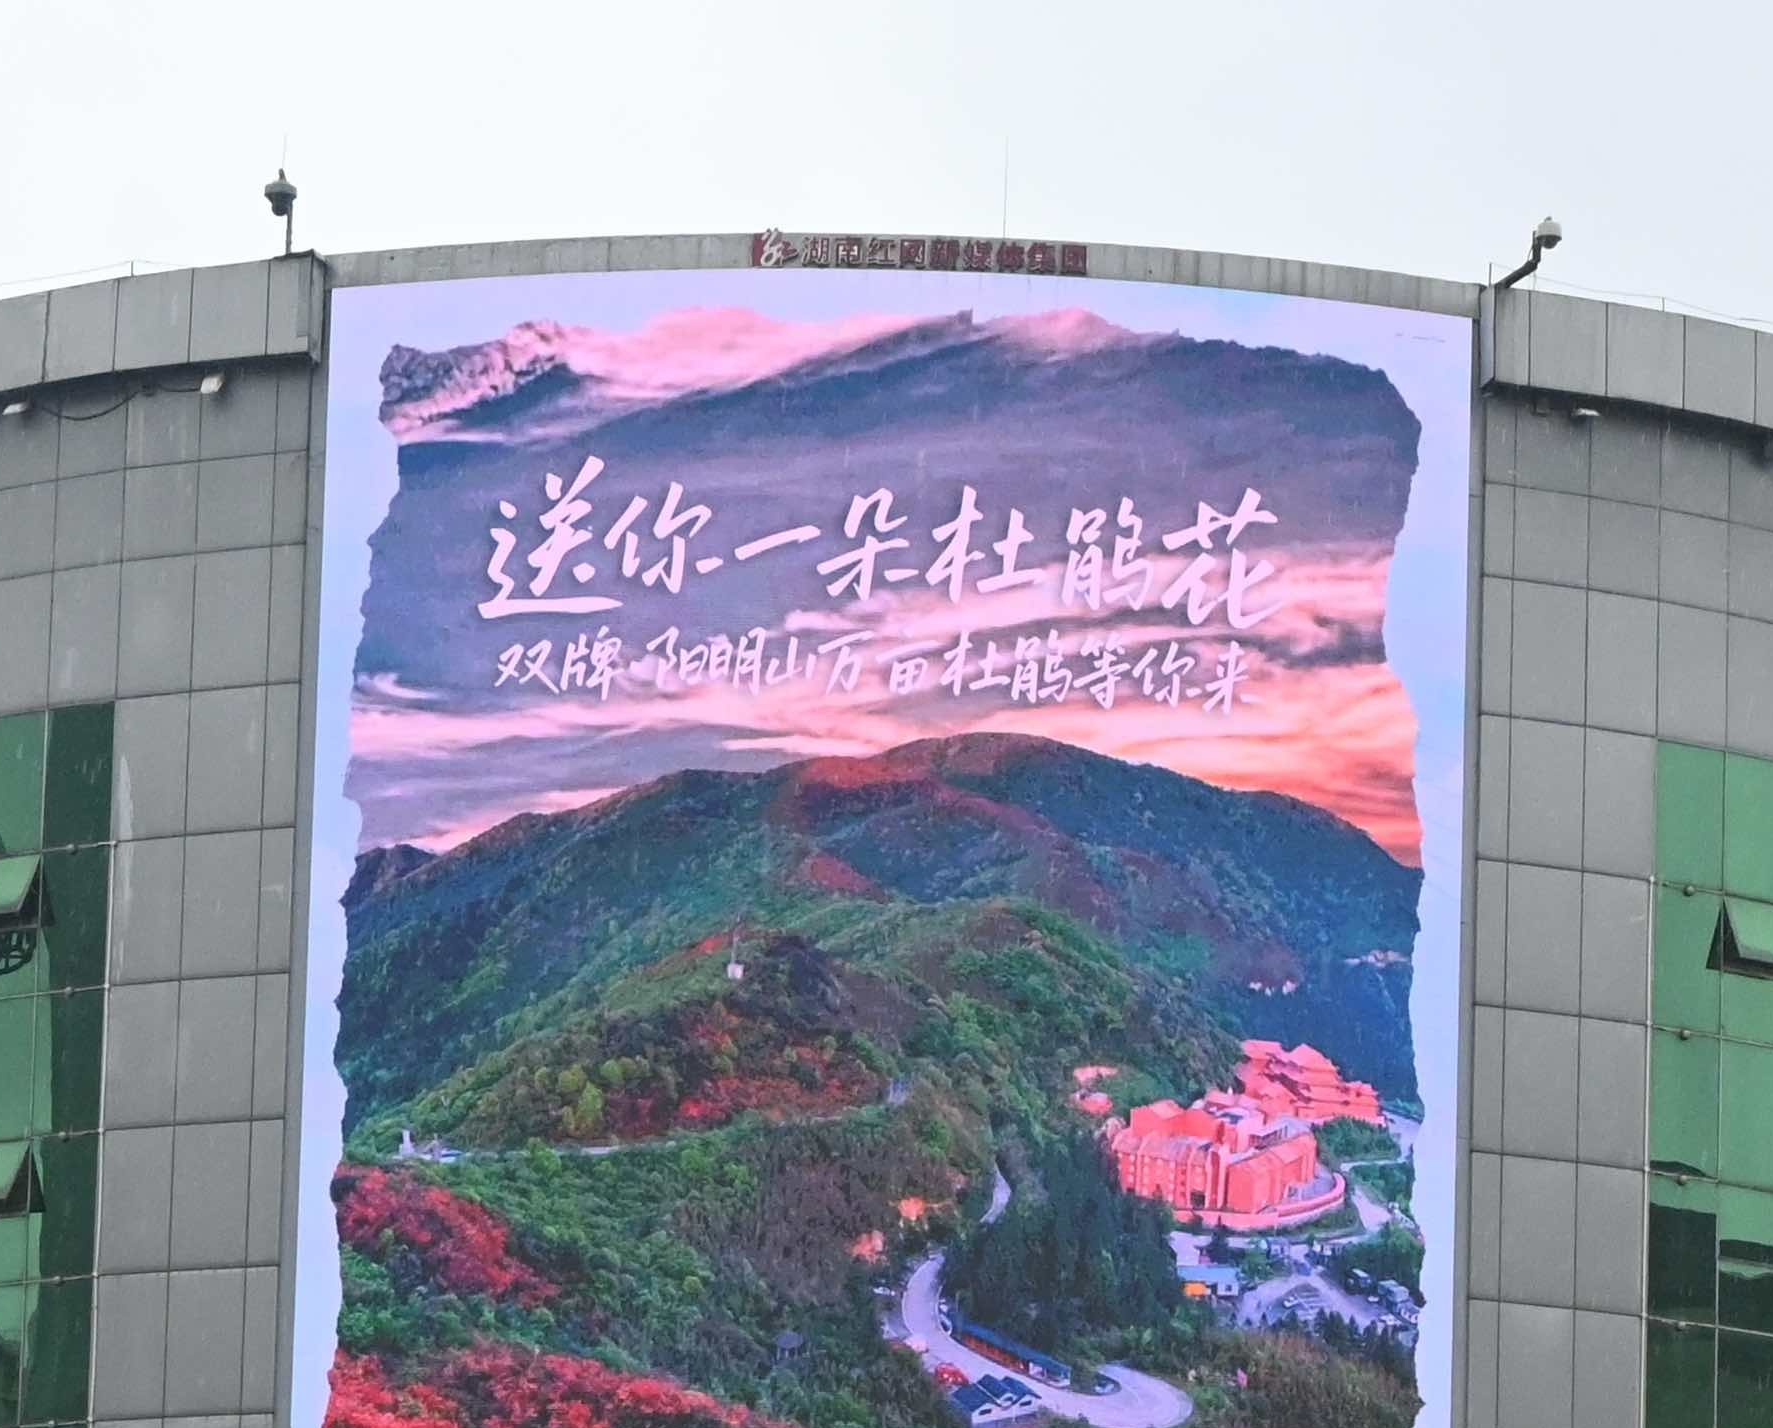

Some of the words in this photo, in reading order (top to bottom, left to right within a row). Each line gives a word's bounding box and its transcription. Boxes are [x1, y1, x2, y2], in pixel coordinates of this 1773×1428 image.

[800, 234, 1089, 276] 湖南红网新媒体集团
[477, 455, 1291, 630] 送你一朵杜鹃花
